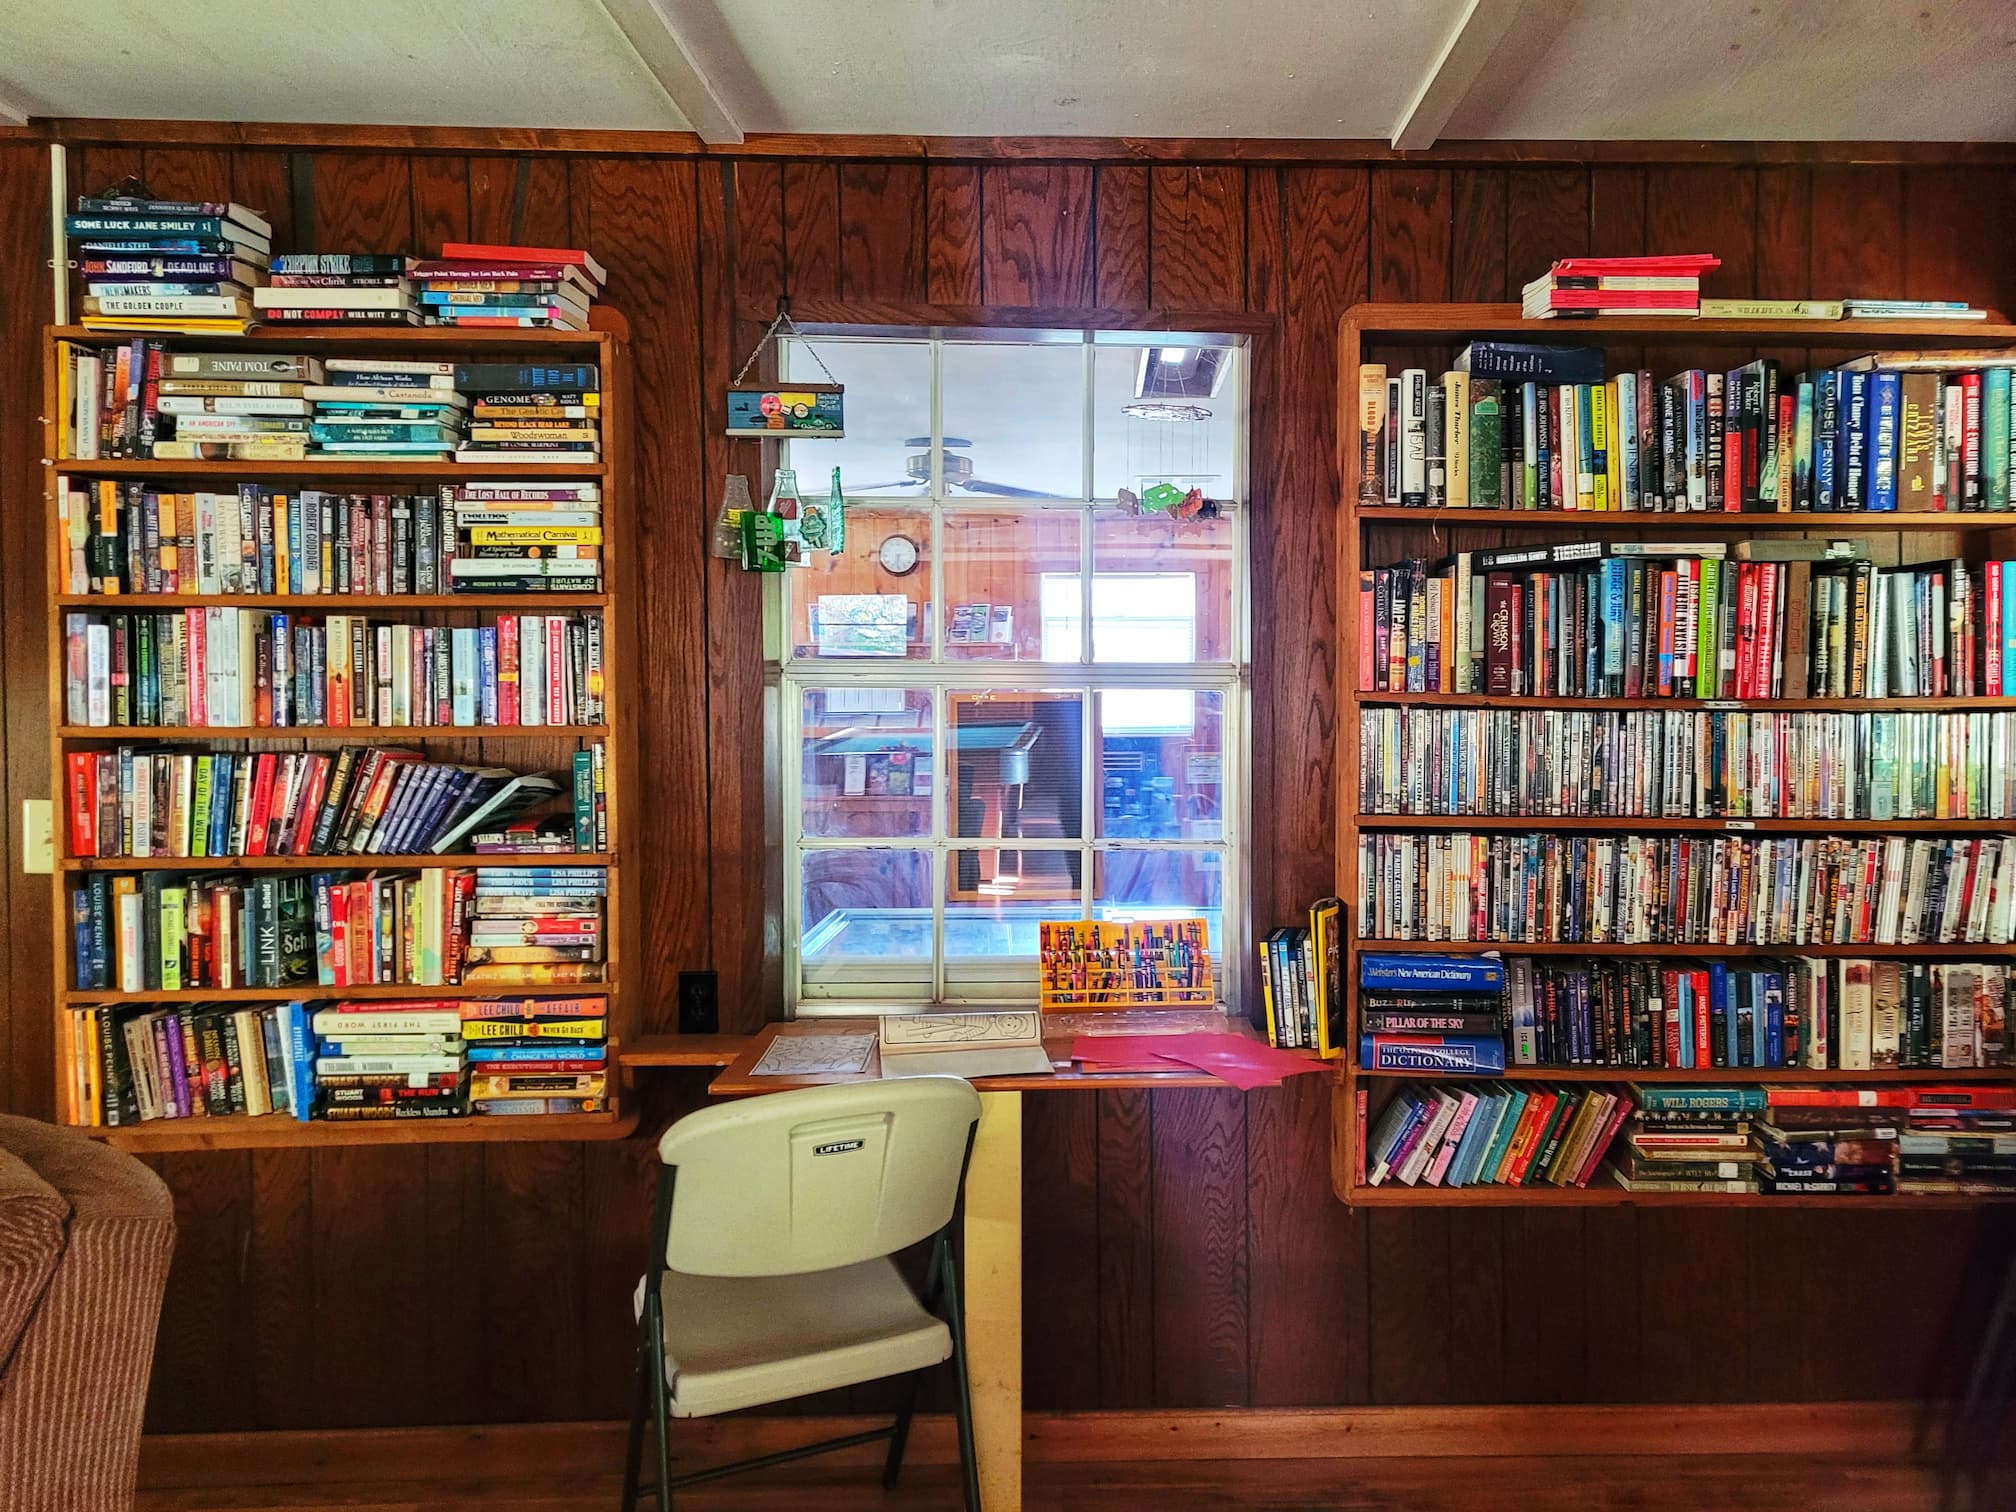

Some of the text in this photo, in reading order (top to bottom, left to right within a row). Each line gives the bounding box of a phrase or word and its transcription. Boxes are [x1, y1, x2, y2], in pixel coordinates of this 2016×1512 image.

[104, 221, 130, 229] LUCK
[160, 222, 195, 230] SMILEY
[107, 260, 147, 273] SANDFORD
[168, 262, 215, 273] DEADLINE
[124, 302, 152, 310] GOLDEN
[155, 302, 182, 310] COUPLE
[267, 310, 344, 319] DO NOT COMPLY
[212, 361, 270, 372] TOM PAINE
[486, 396, 531, 404] GENOME
[1414, 376, 1422, 415] PHILIP KERR
[1664, 386, 1673, 417] JEANNE
[1745, 386, 1753, 410] Parker
[1847, 374, 1864, 429] Tom Clancy
[1368, 401, 1376, 425] BLOOD
[1539, 400, 1548, 448] IRIS JOHANSEN
[1367, 428, 1376, 443] AND
[1666, 430, 1674, 453] DAMS
[1821, 380, 1834, 486] LOUISE PENNY
[1966, 386, 1978, 476] THE BOURNE EVOLUTION
[1847, 432, 1863, 499] Debt of Honor
[478, 489, 493, 500] LOST
[521, 490, 549, 500] RECORDS
[306, 503, 317, 531] ROBERT
[441, 487, 455, 552] JOHN SANDFORD
[486, 531, 577, 541] Mathematical Carnival
[1610, 562, 1623, 592] JUDGE
[1429, 593, 1438, 614] Nelson
[1610, 601, 1622, 624] JURY
[1490, 613, 1500, 646] CROWN
[1499, 609, 1509, 653] CRIMSON
[590, 630, 600, 671] THE ENEMY
[326, 753, 350, 806] JOHN SANDFORD
[195, 768, 208, 842] DAY OF THE WOLF
[93, 883, 104, 951] LOUISE PENNY
[260, 926, 274, 963] LINK
[1398, 968, 1412, 978] New
[1412, 969, 1441, 979] American
[1441, 969, 1472, 981] Dictionary
[1698, 995, 1706, 1014] JAMES
[482, 1024, 524, 1035] LEE CHILD
[1386, 1018, 1464, 1029] PILLAR OF THE SKY
[102, 1016, 114, 1085] LOUISE PENNY
[1381, 1055, 1472, 1068] DICTIONARY
[1663, 1097, 1728, 1108] WILL ROGERS
[820, 1142, 858, 1153] LIFETIME
